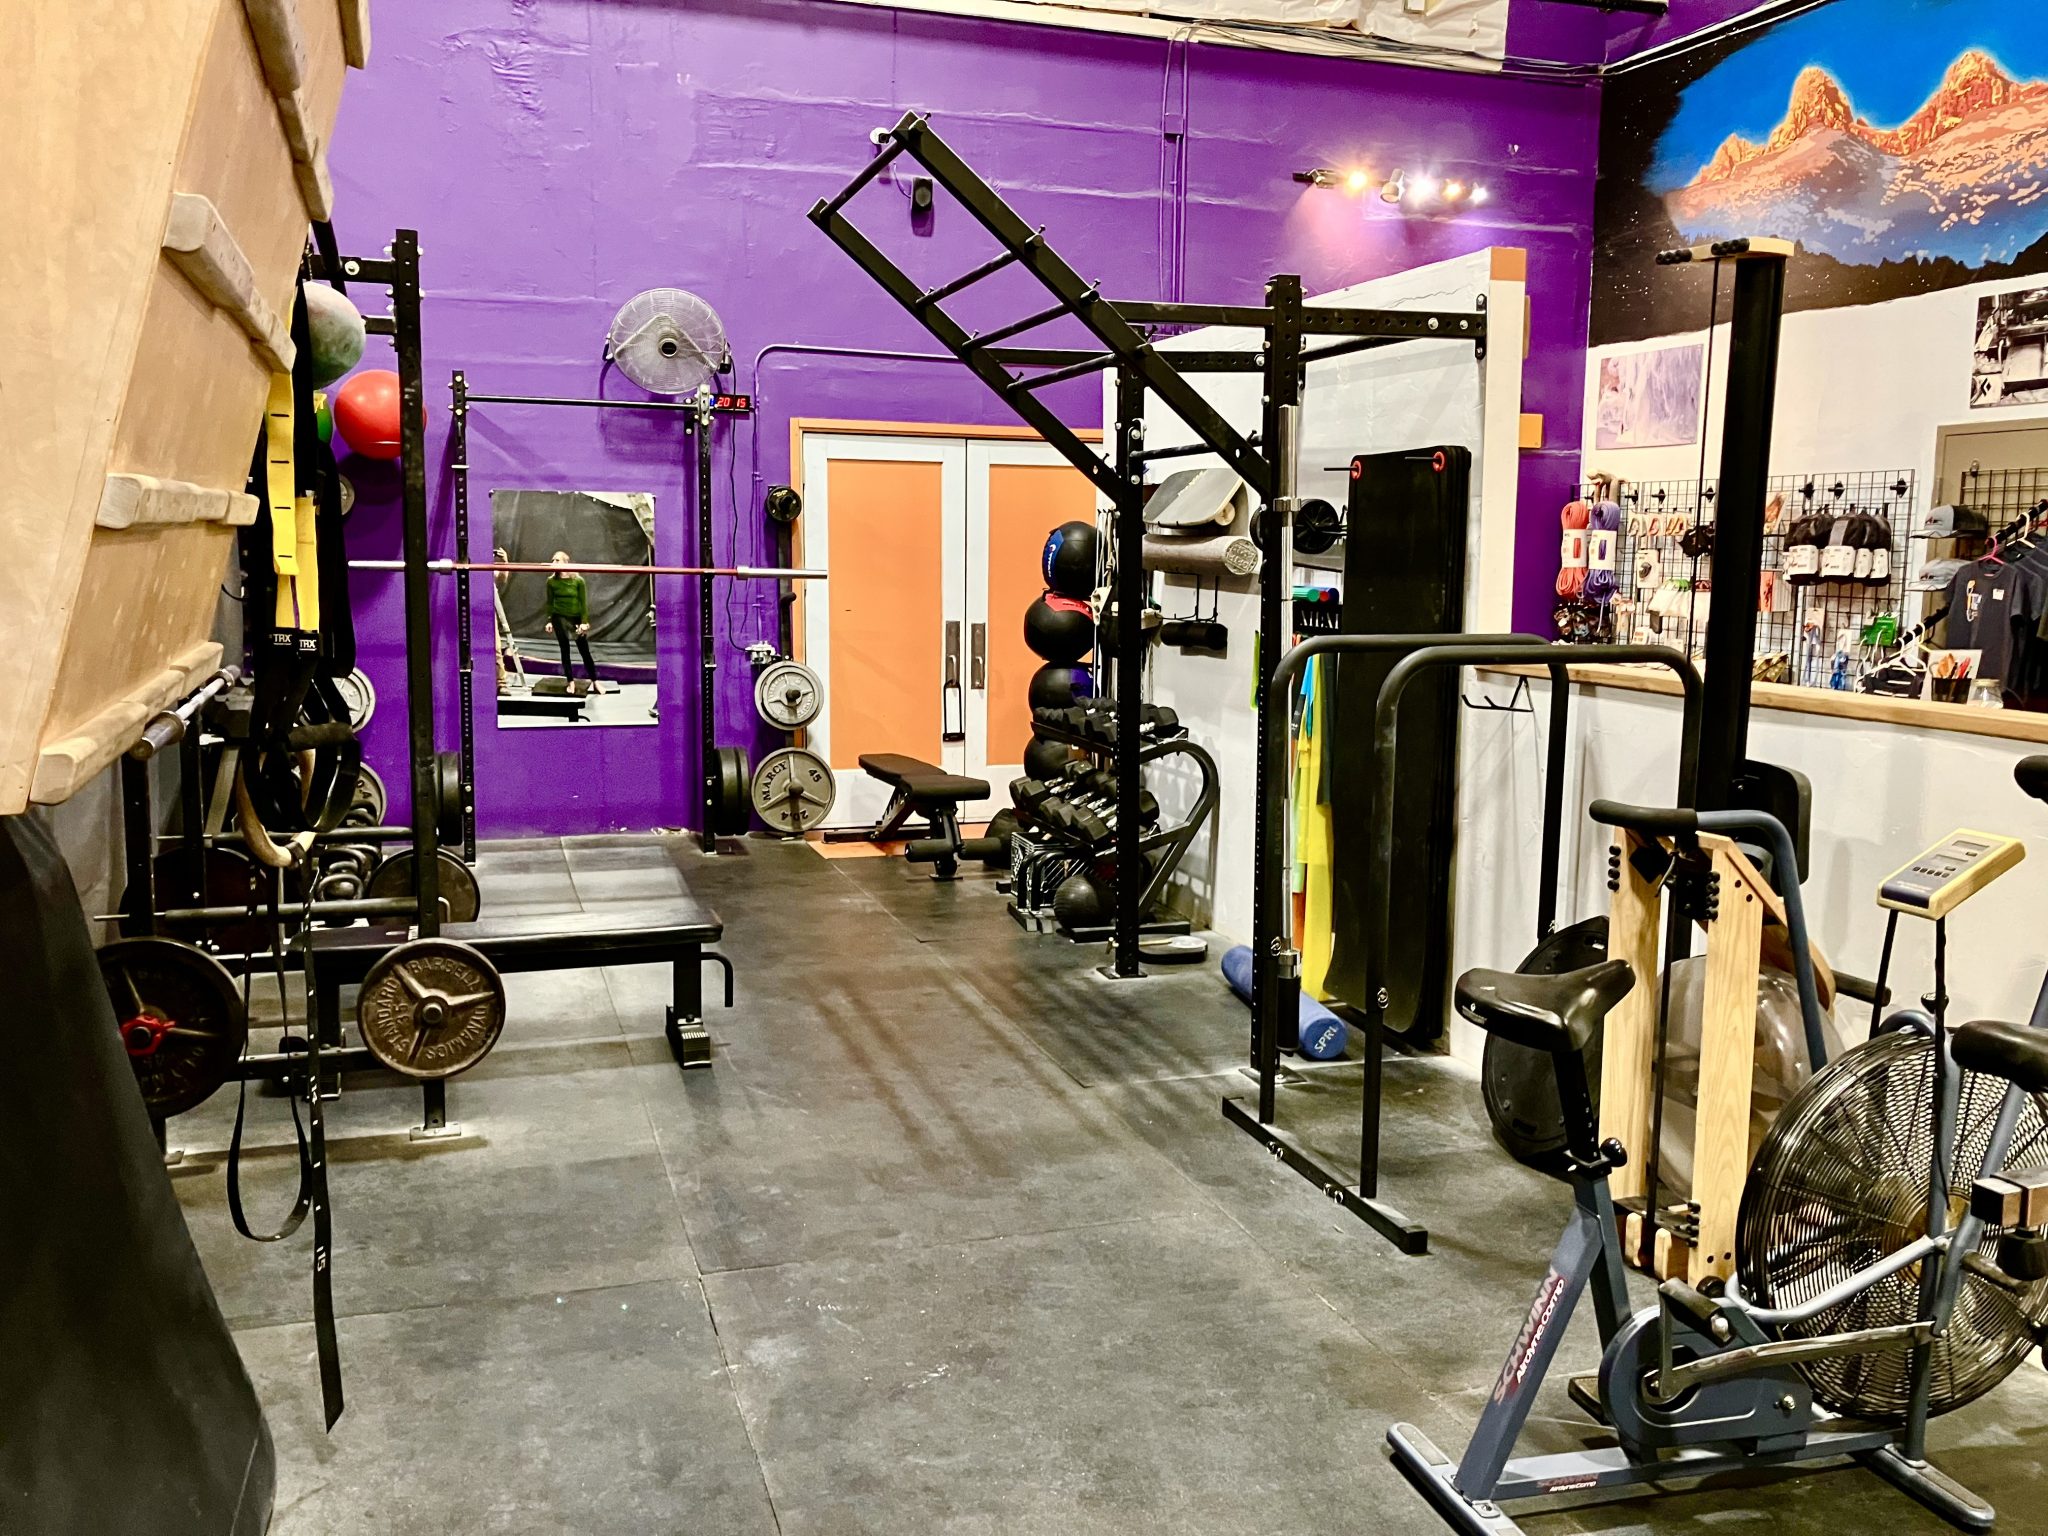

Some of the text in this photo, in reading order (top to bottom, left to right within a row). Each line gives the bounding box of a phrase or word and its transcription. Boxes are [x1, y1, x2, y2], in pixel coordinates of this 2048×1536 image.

[273, 633, 292, 643] TRX
[299, 639, 317, 649] TRX
[761, 760, 788, 801] MARCY
[808, 767, 822, 783] 45
[408, 957, 480, 991] BARBELL
[377, 976, 411, 1052] STANDARD
[1314, 1025, 1337, 1053] SPRI
[1494, 1265, 1558, 1405] SCHWINN
